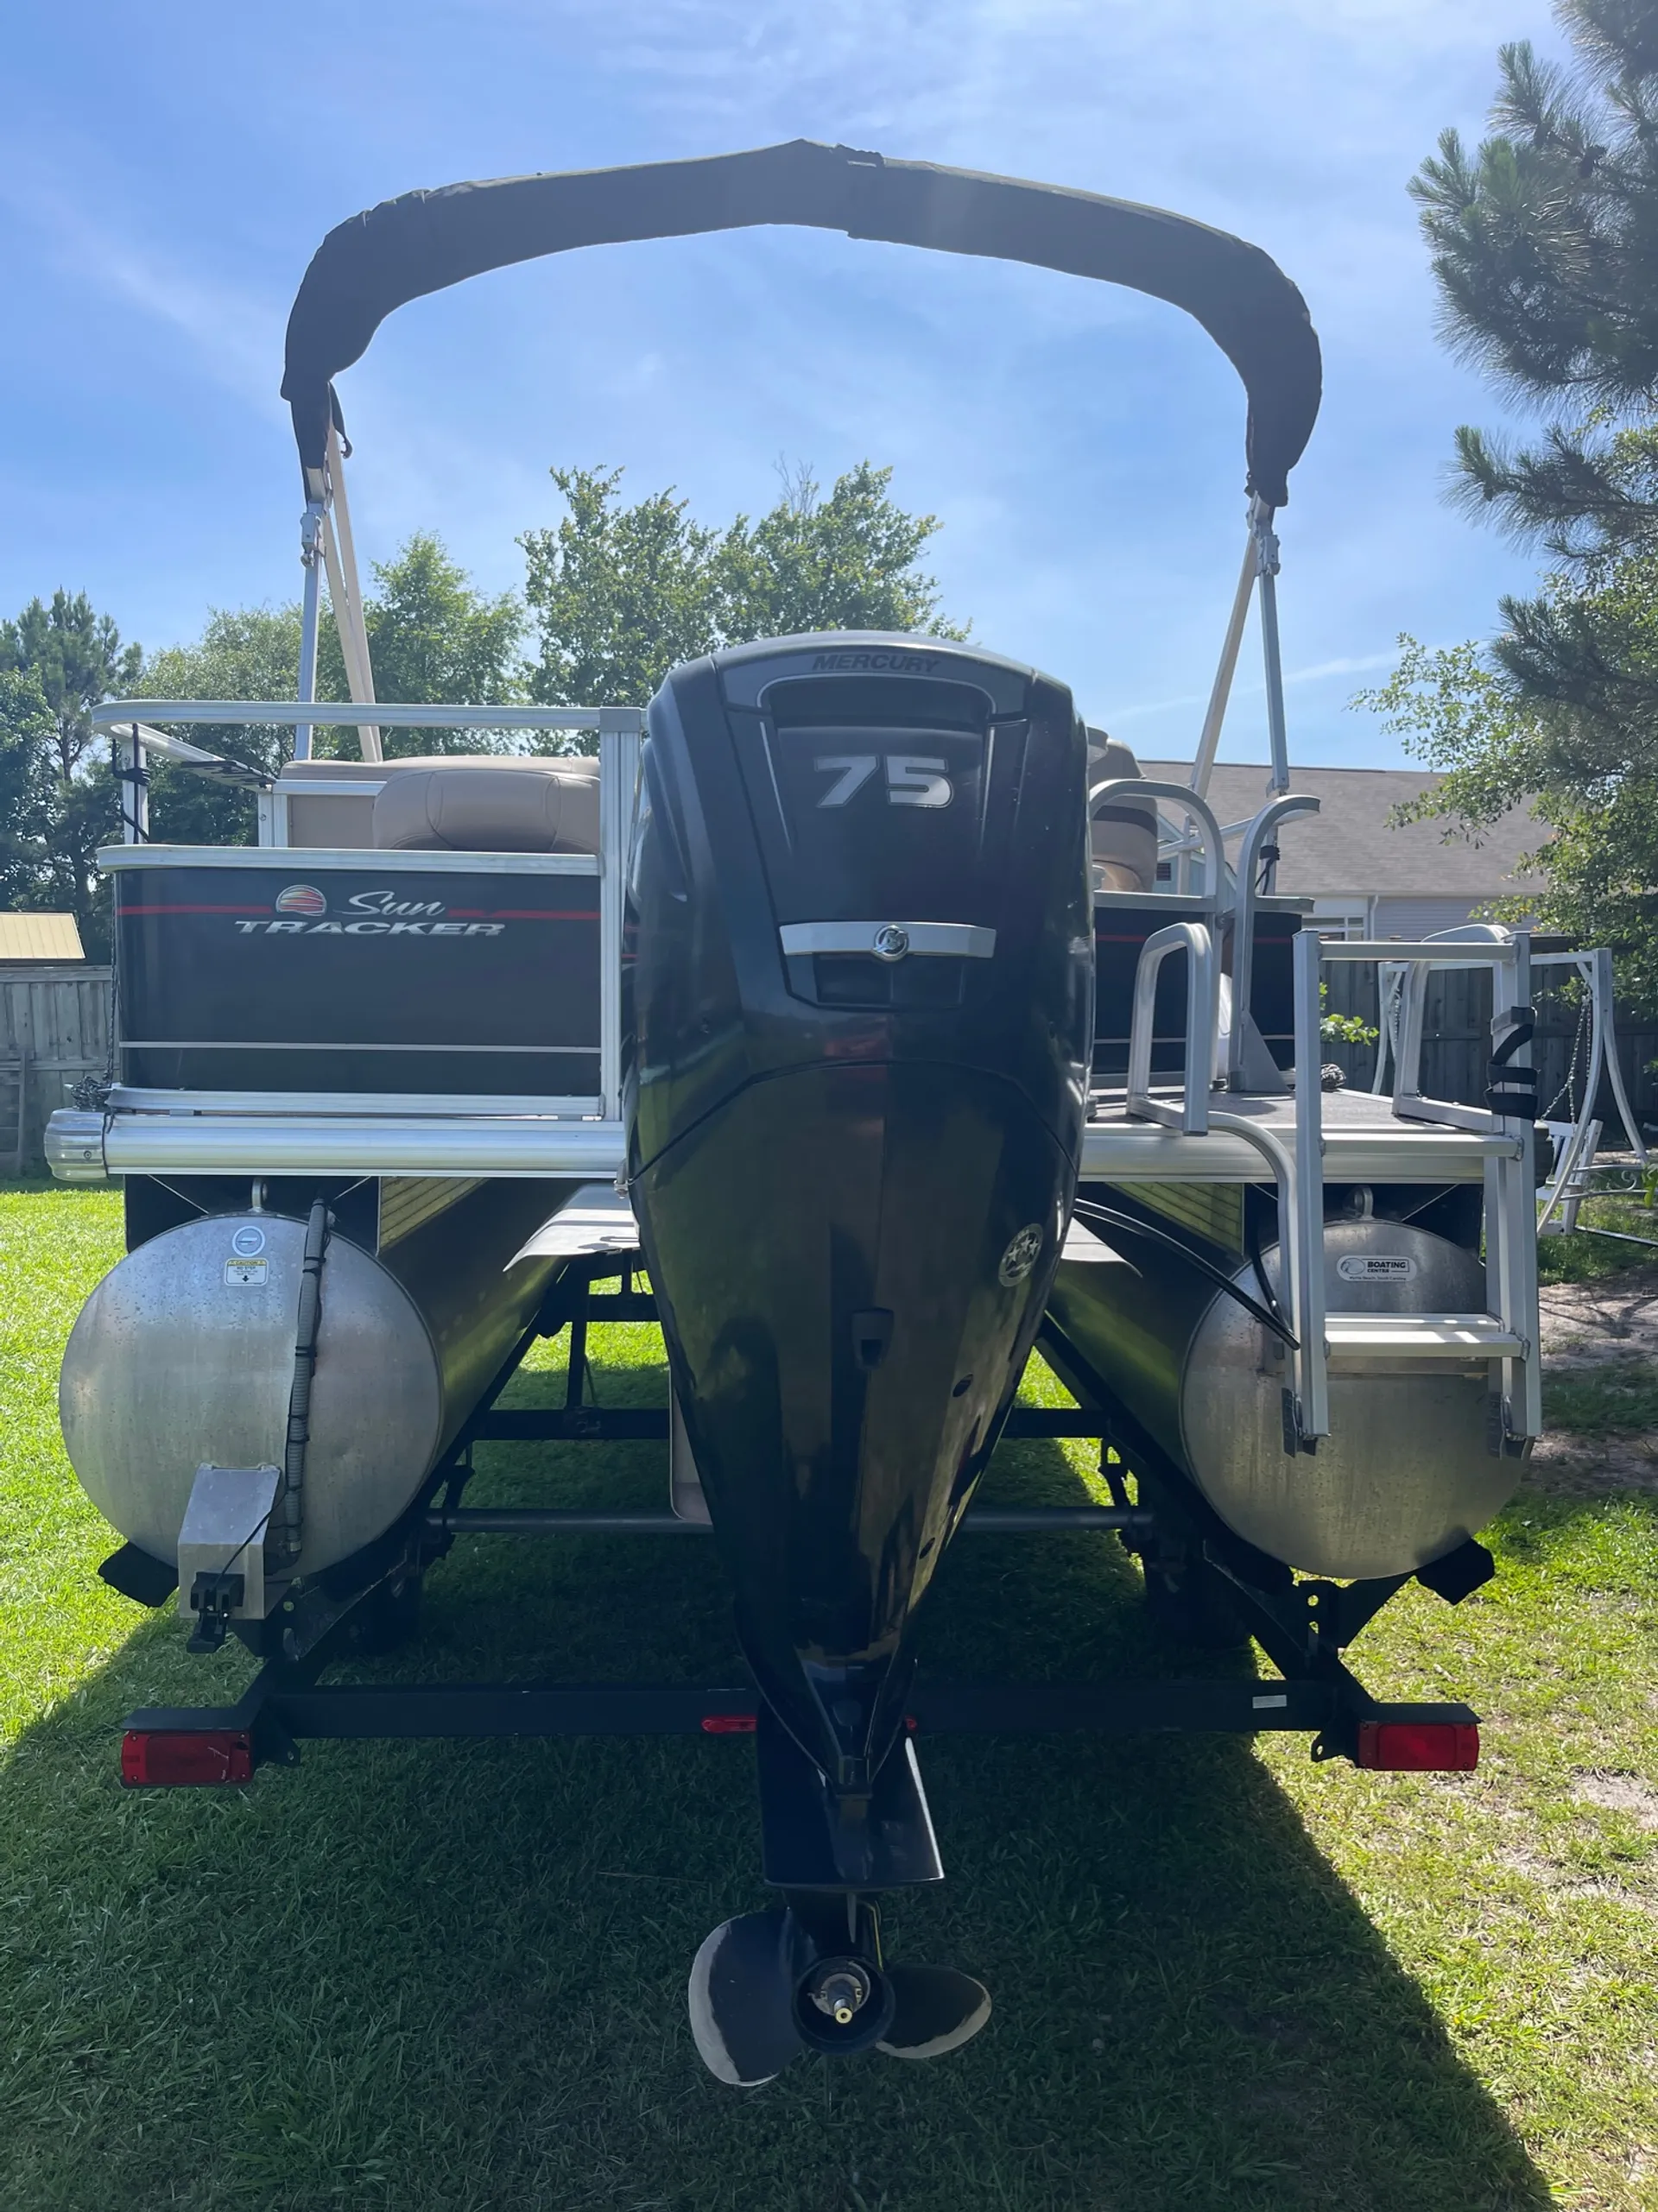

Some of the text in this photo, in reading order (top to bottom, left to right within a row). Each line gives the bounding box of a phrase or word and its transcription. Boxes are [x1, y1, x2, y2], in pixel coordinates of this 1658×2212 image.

[812, 654, 941, 673] MERCURY
[813, 754, 954, 808] 75
[332, 890, 446, 916] Sun
[235, 920, 506, 937] TRACKER
